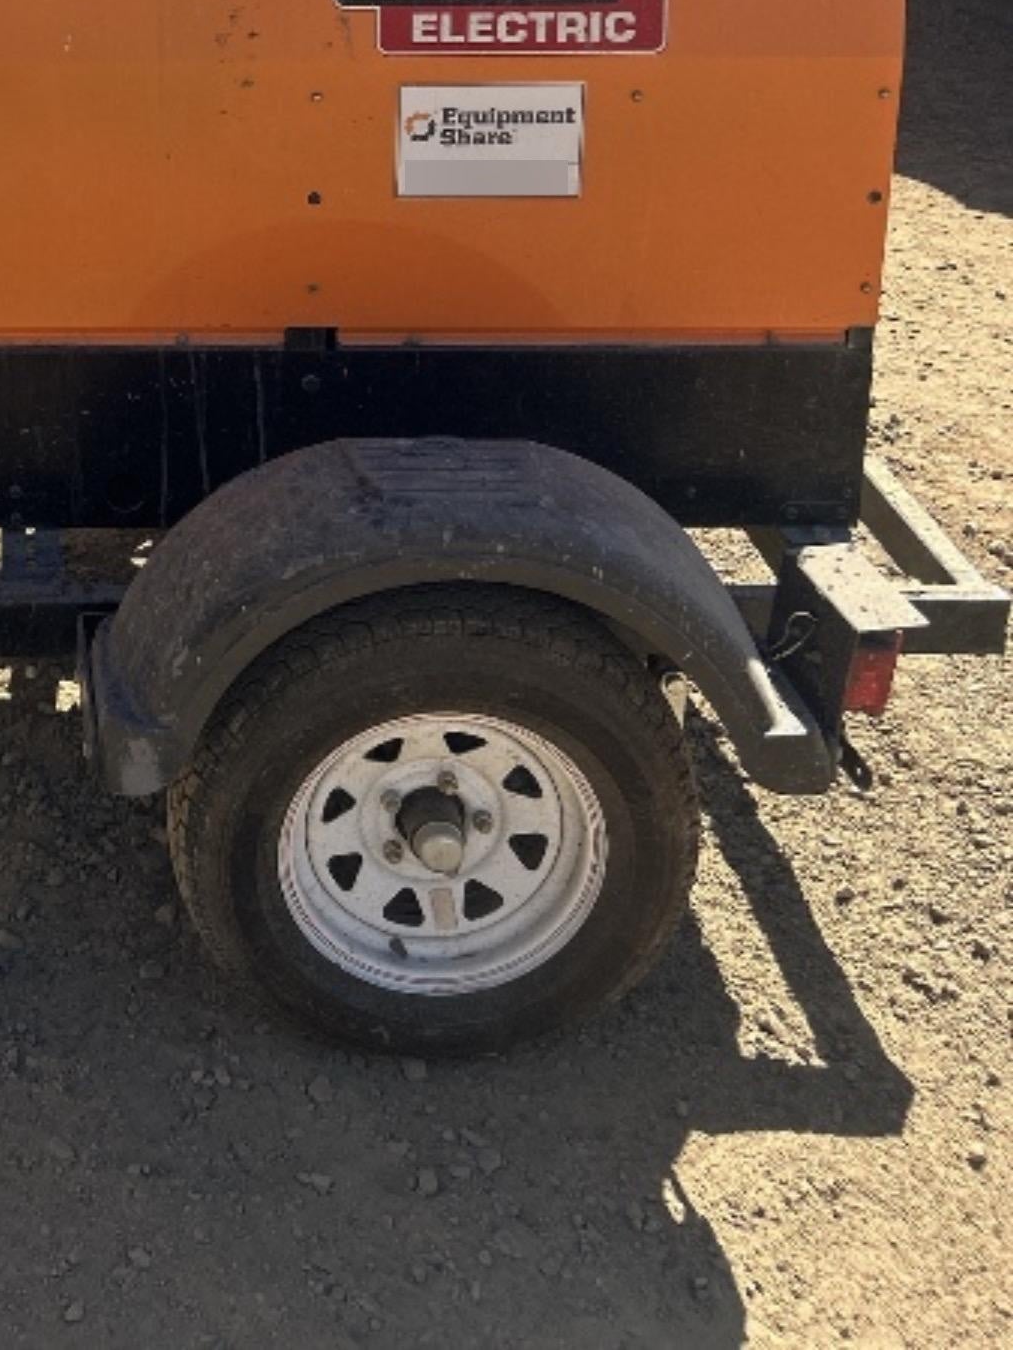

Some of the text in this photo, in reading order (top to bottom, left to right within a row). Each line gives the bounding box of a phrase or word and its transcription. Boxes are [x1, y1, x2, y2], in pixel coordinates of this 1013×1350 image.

[412, 11, 638, 45] ELECTRIC
[442, 107, 576, 129] Equipment
[440, 129, 513, 145] Share
